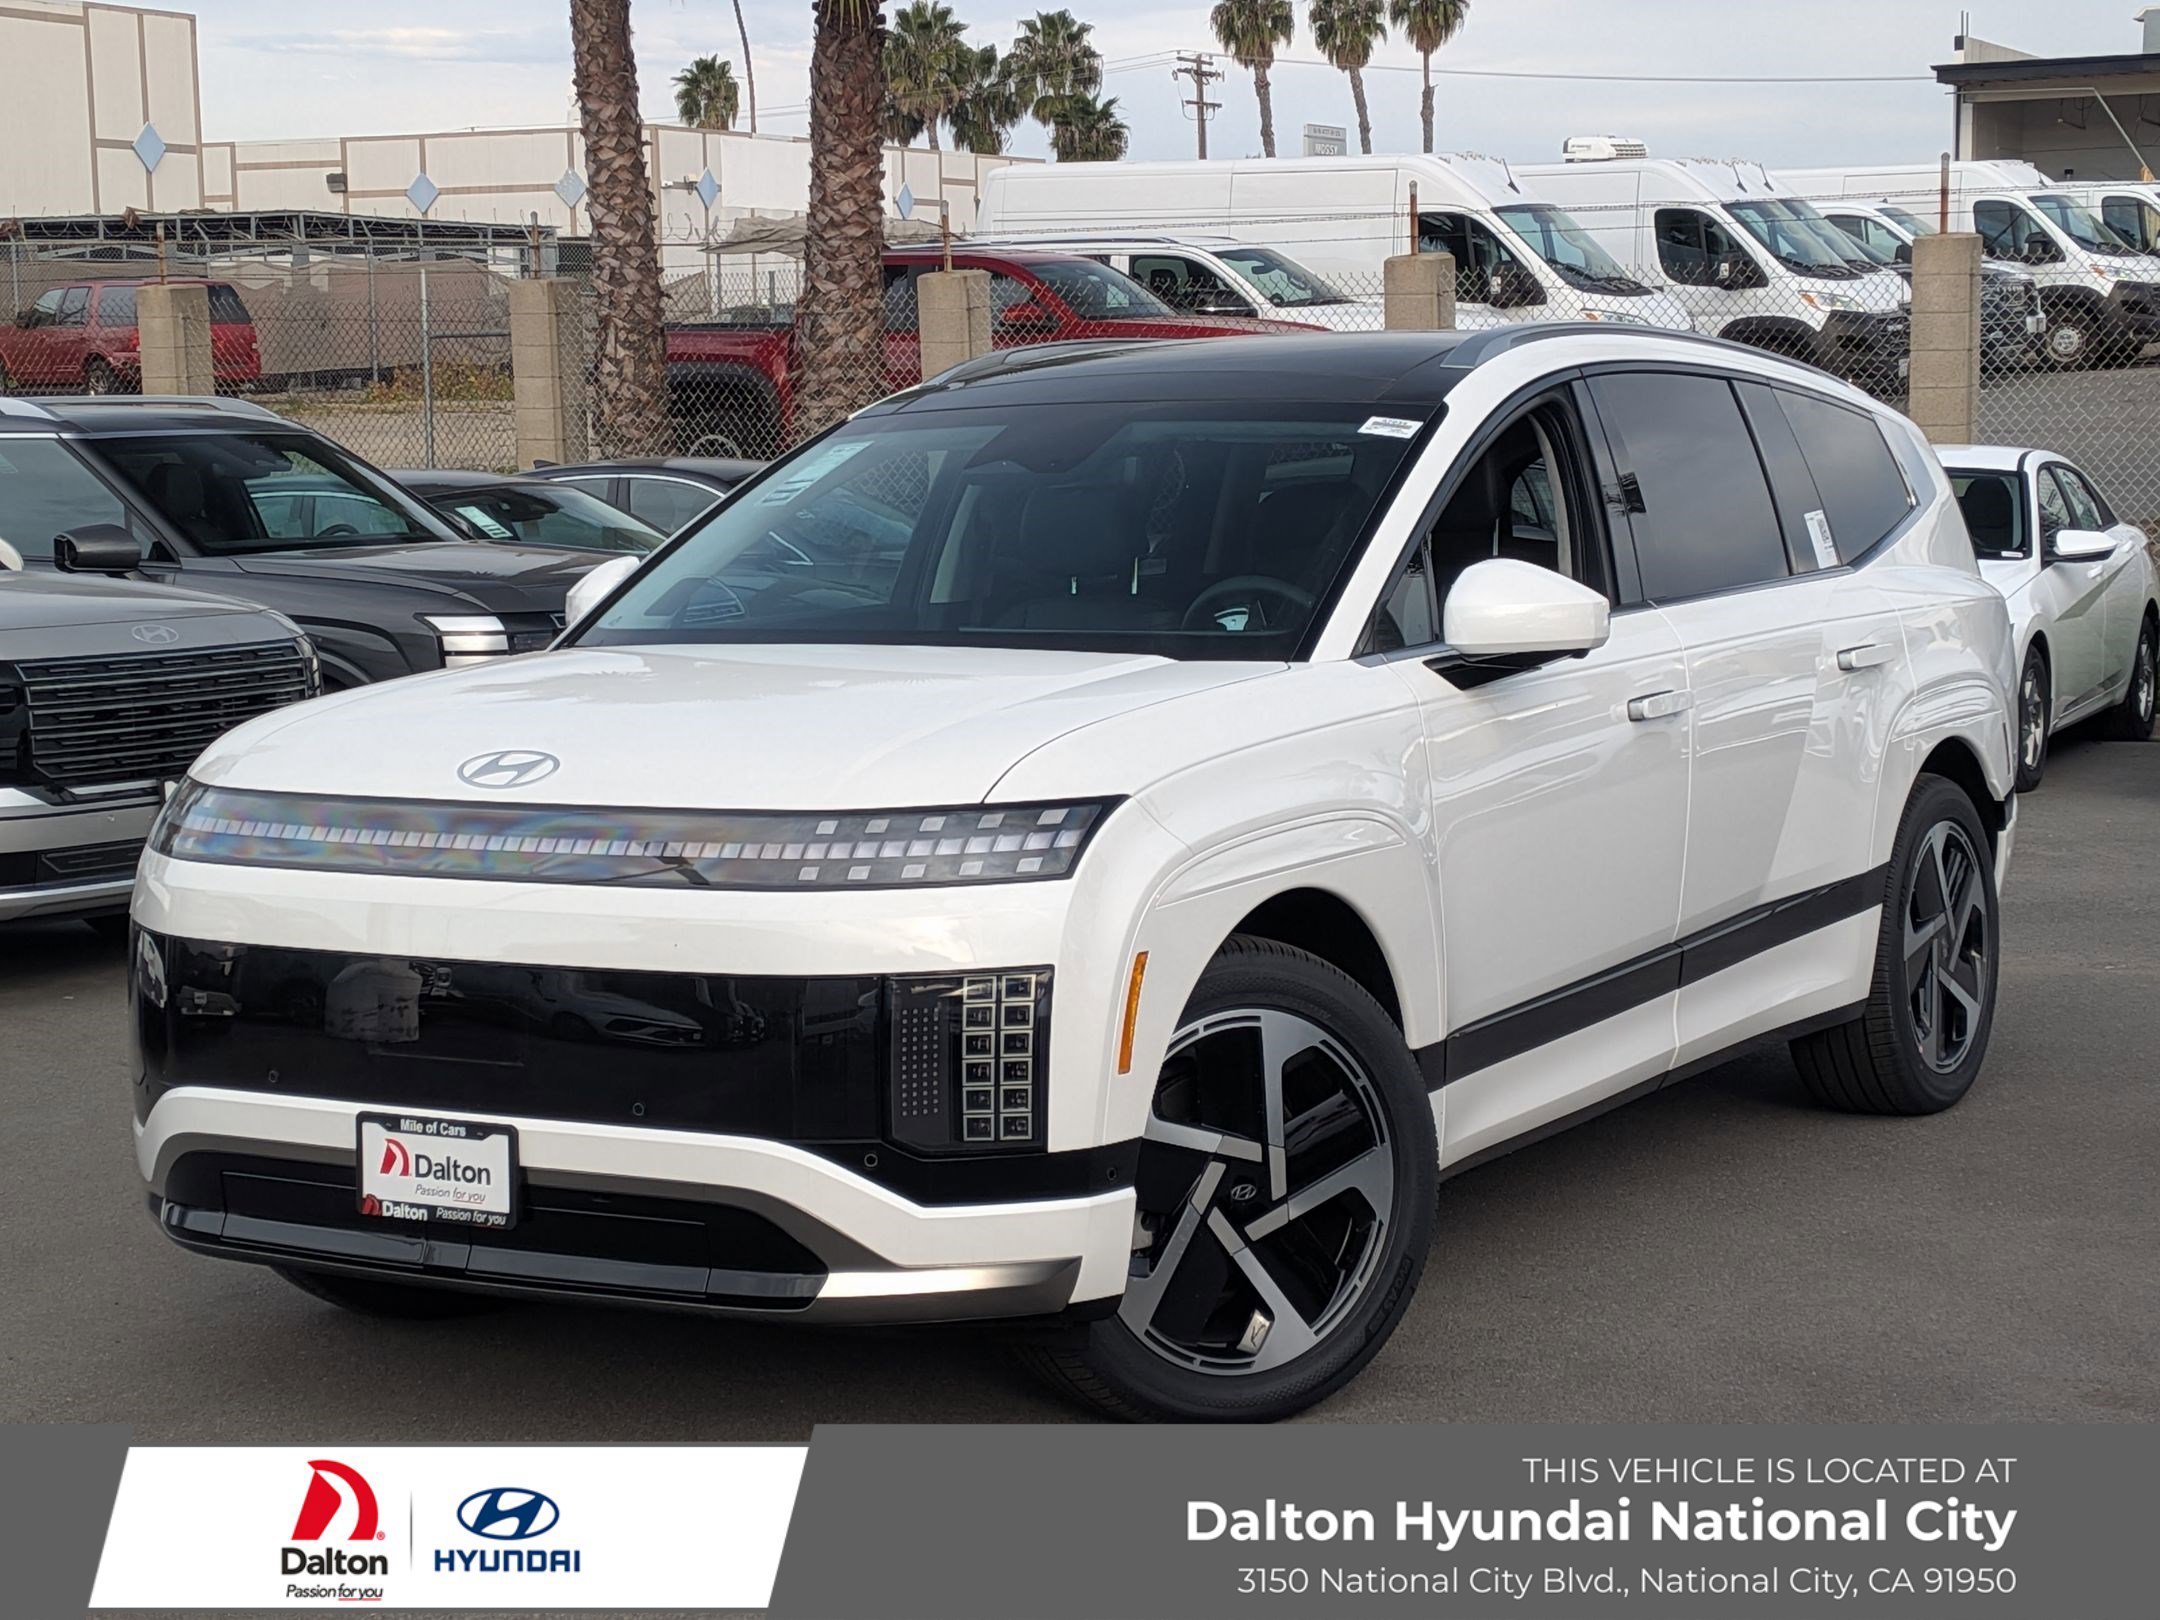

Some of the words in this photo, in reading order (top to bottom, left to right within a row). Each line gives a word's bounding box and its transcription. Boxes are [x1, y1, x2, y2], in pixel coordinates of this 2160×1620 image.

[400, 1118, 424, 1133] Mile
[425, 1121, 438, 1134] of
[440, 1122, 467, 1137] Cars
[415, 1154, 491, 1186] Dalton
[415, 1184, 451, 1198] Passion
[452, 1187, 467, 1199] for
[468, 1192, 486, 1203] you
[382, 1201, 428, 1221] Dalton
[436, 1207, 472, 1221] Passion
[472, 1211, 487, 1223] for
[487, 1215, 507, 1226] you
